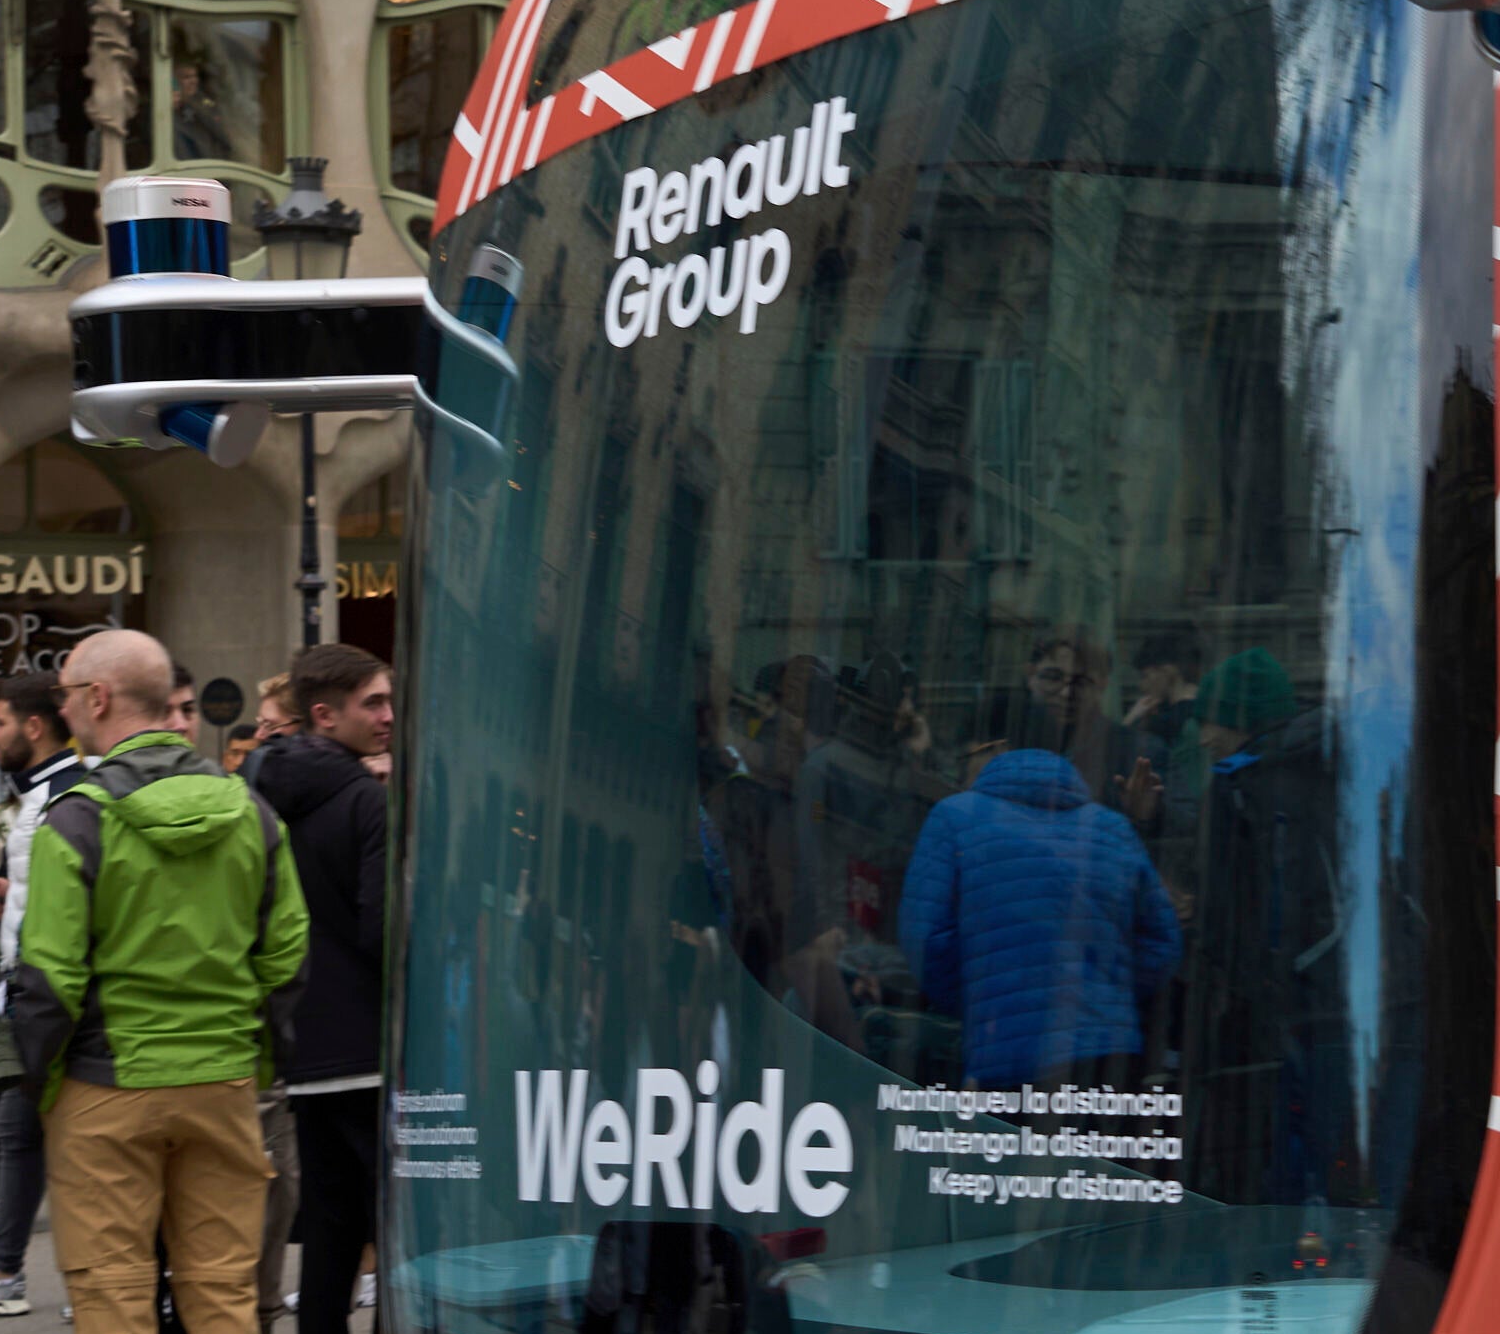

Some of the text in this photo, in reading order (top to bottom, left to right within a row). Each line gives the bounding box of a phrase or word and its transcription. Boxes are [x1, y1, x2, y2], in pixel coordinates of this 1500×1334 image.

[614, 96, 857, 259] Renault
[604, 228, 791, 348] Group
[9, 649, 70, 676] ACC
[877, 1083, 1183, 1121] Mantingueu la distància
[514, 1059, 853, 1217] WeRide
[894, 1125, 1183, 1162] Mantenga la distancia
[929, 1167, 1184, 1205] Keep your distance
